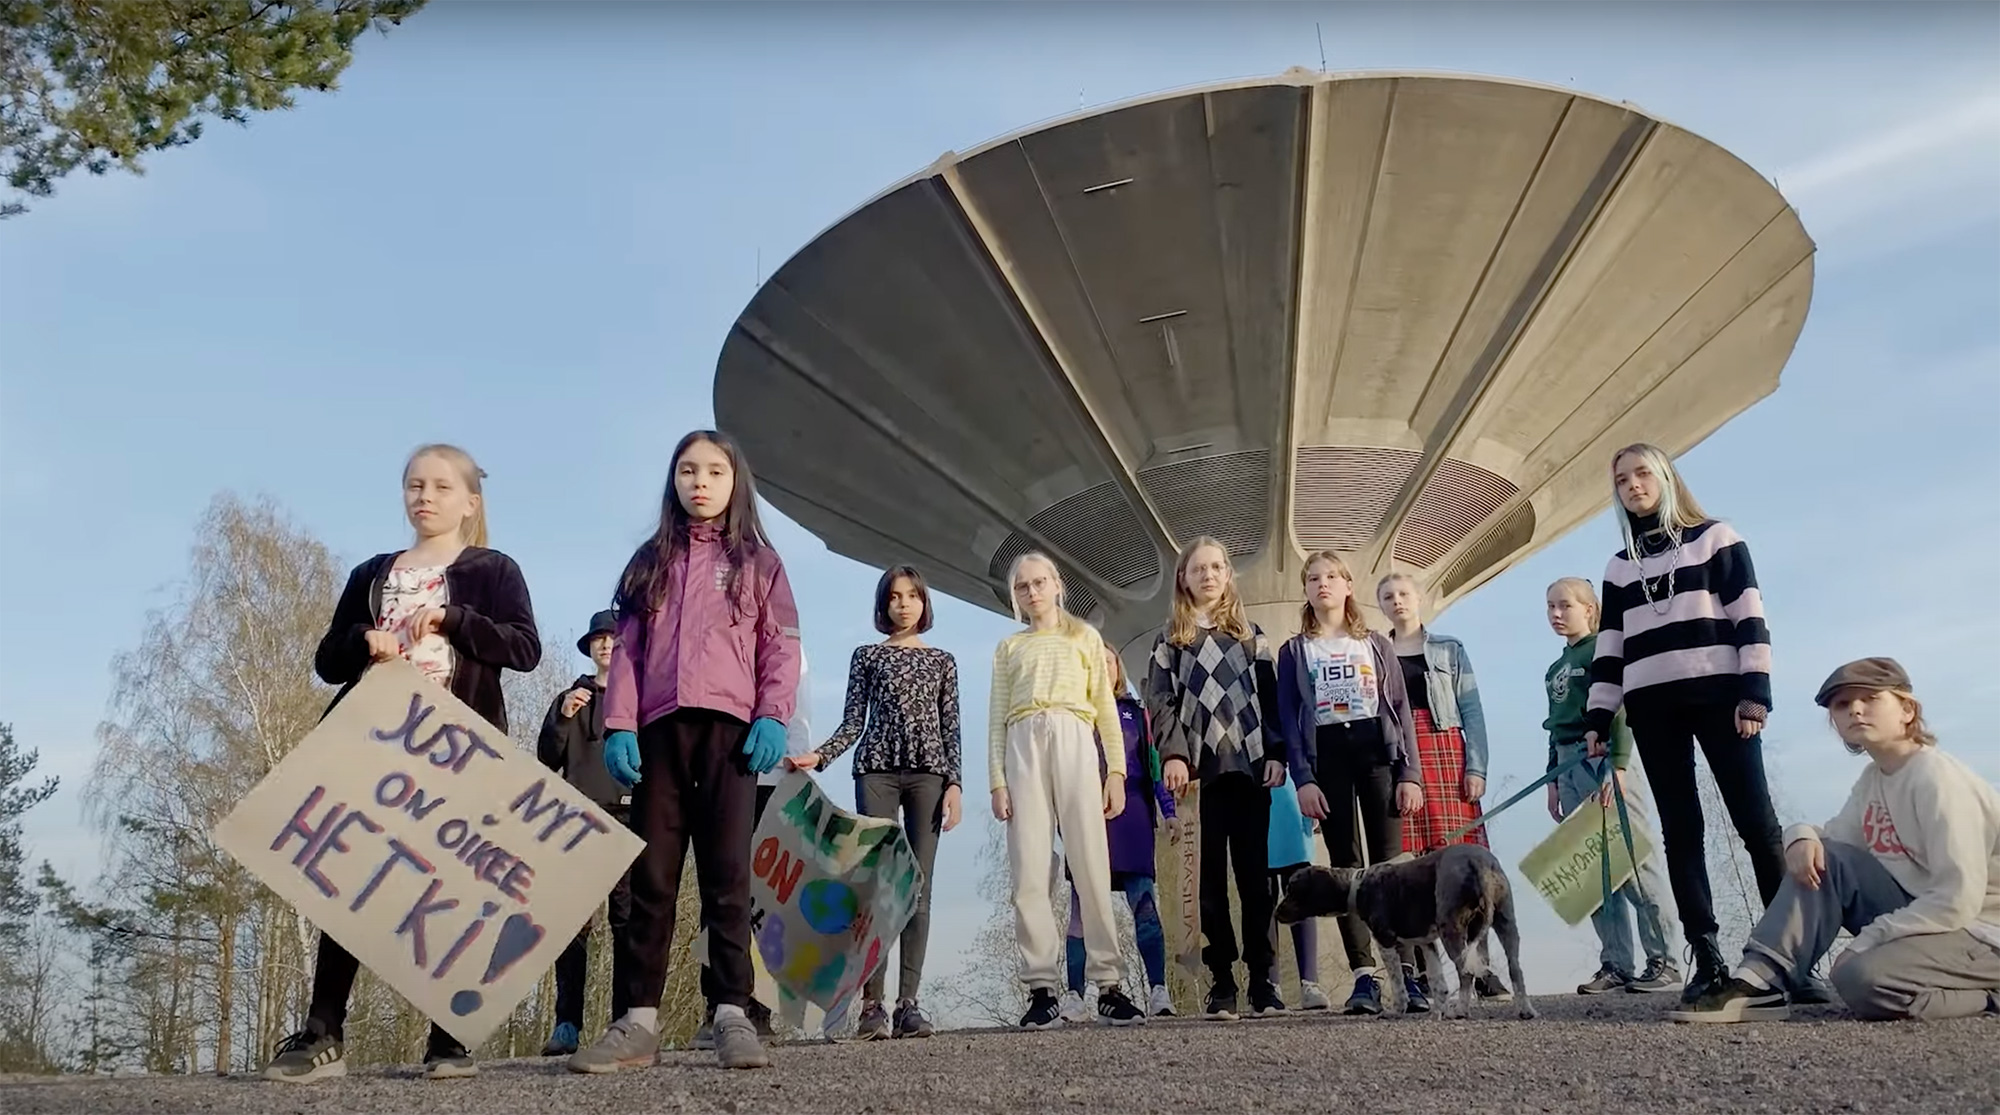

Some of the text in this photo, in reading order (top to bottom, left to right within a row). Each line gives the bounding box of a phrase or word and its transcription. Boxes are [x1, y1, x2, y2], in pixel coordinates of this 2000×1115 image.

[1323, 664, 1355, 681] ISD
[371, 693, 610, 853] JUST NYT
[375, 771, 445, 821] ON
[753, 836, 806, 905] ON
